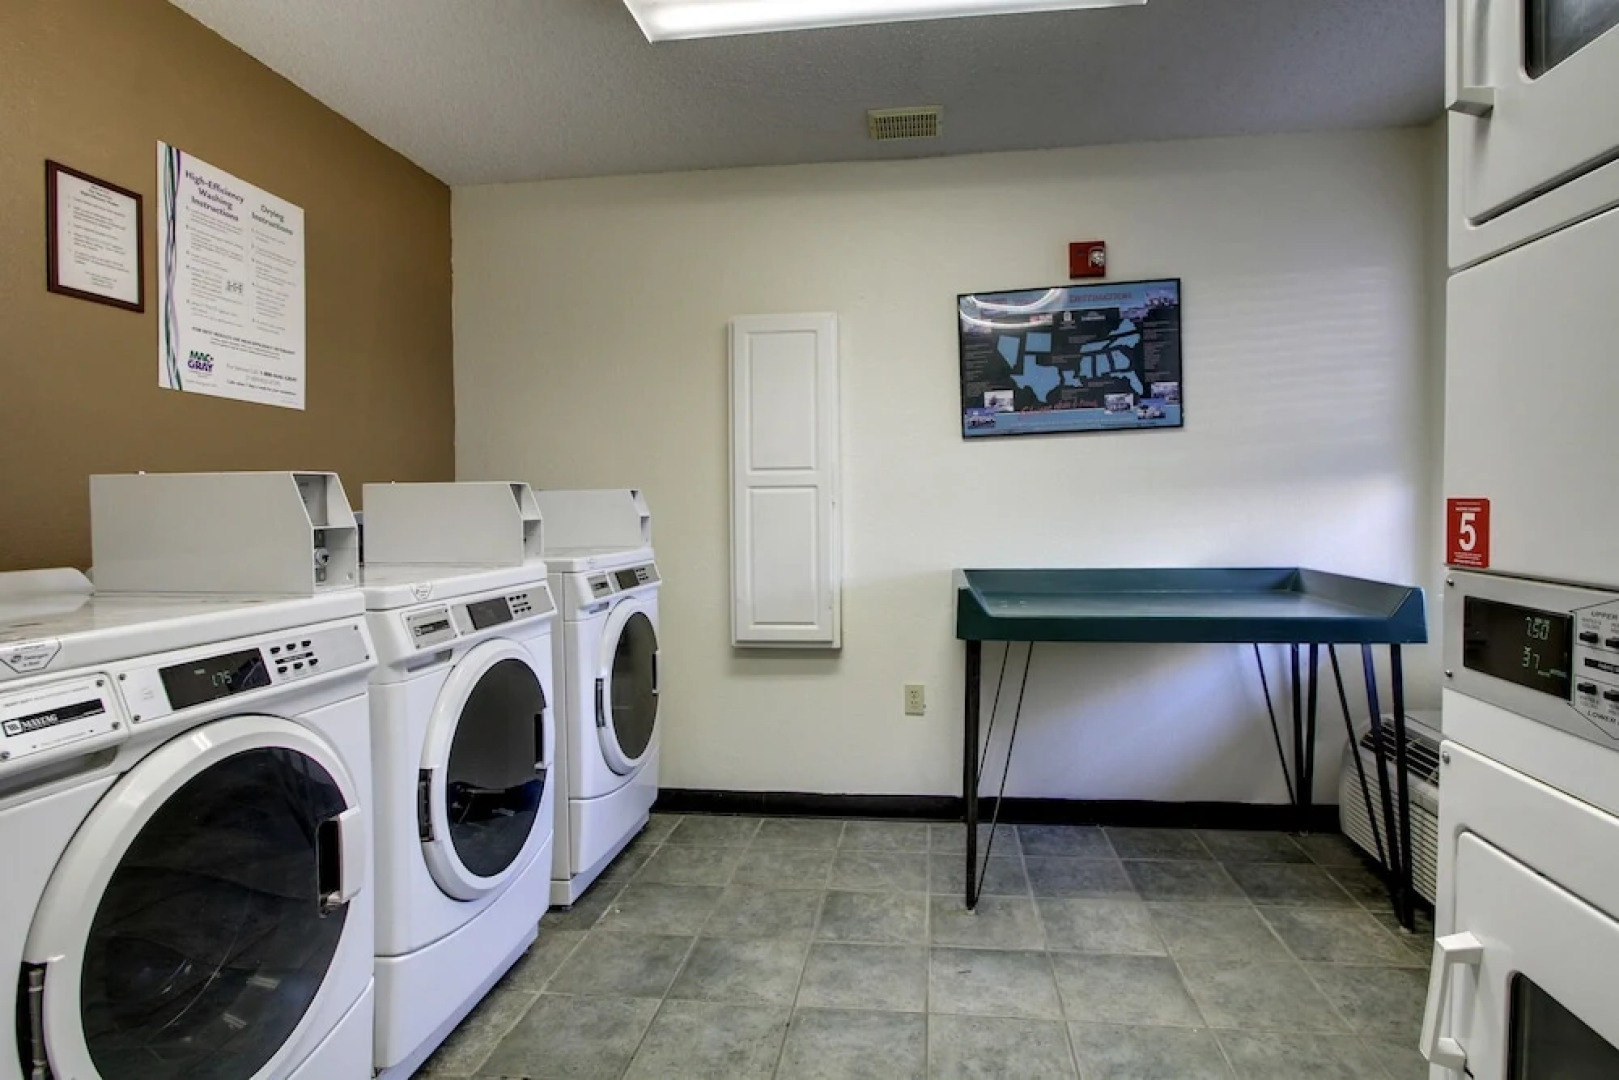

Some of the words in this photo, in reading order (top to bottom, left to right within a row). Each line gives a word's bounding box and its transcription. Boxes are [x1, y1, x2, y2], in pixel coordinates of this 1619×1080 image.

[186, 169, 244, 205] High-Efficiency
[198, 187, 233, 211] Washing
[190, 195, 239, 222] Instructions
[260, 203, 285, 223] Drying
[251, 211, 294, 236] Instructions
[187, 359, 215, 373] GRAY
[1458, 512, 1477, 552] 5
